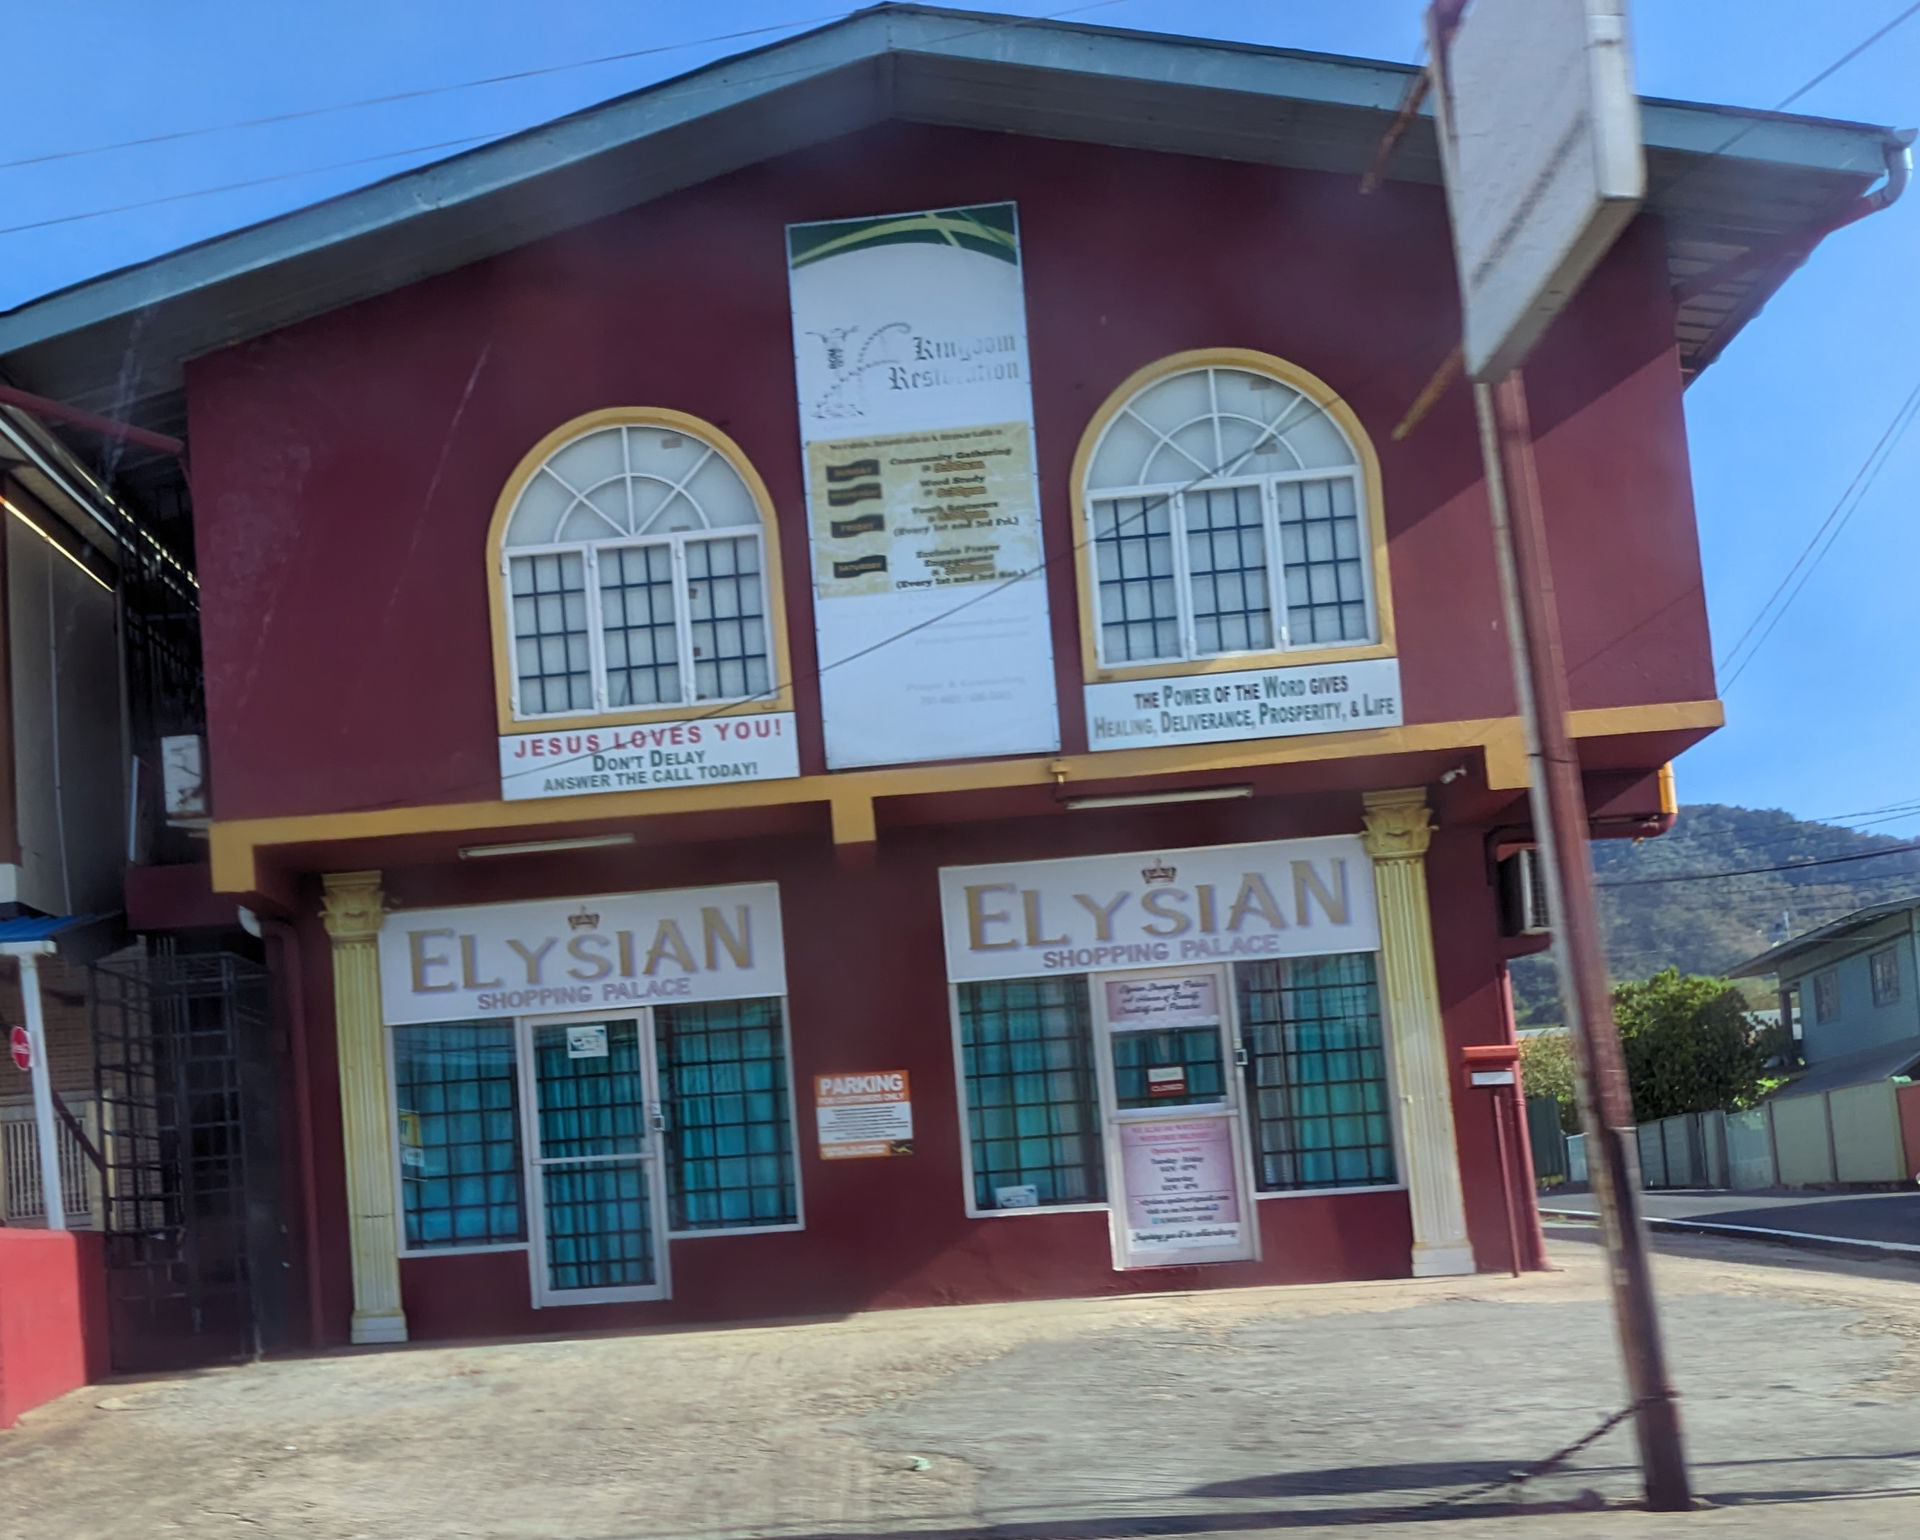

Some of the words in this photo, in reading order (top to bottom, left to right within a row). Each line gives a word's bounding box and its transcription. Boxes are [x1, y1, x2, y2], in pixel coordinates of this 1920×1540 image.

[889, 362, 1019, 390] Restation
[956, 447, 1012, 460] Gathering
[919, 478, 950, 488] Word
[952, 474, 985, 486] Study
[1133, 691, 1160, 710] THE
[1162, 684, 1212, 709] POWER
[1214, 685, 1231, 703] OF
[1234, 682, 1261, 702] THE
[1262, 674, 1306, 699] WORD
[1309, 674, 1349, 695] GIVES
[1350, 700, 1360, 718] &
[1362, 692, 1395, 717] LIFE
[514, 734, 600, 758] JESUS
[614, 725, 702, 750] LOVES
[714, 718, 782, 742] YOU!
[650, 748, 706, 769] DELAY
[543, 772, 611, 792] ANSWER
[617, 769, 648, 786] THE
[652, 765, 693, 783] CALL
[698, 761, 759, 780] TODAY!
[962, 857, 1352, 952] ELYSIAN
[406, 902, 756, 995] ELYSIAN
[1042, 940, 1170, 970] SHOPPING
[1180, 932, 1281, 960] PALACE
[477, 984, 594, 1011] SHOPPING
[602, 976, 693, 1002] PALACE
[820, 1073, 904, 1096] PARKING
